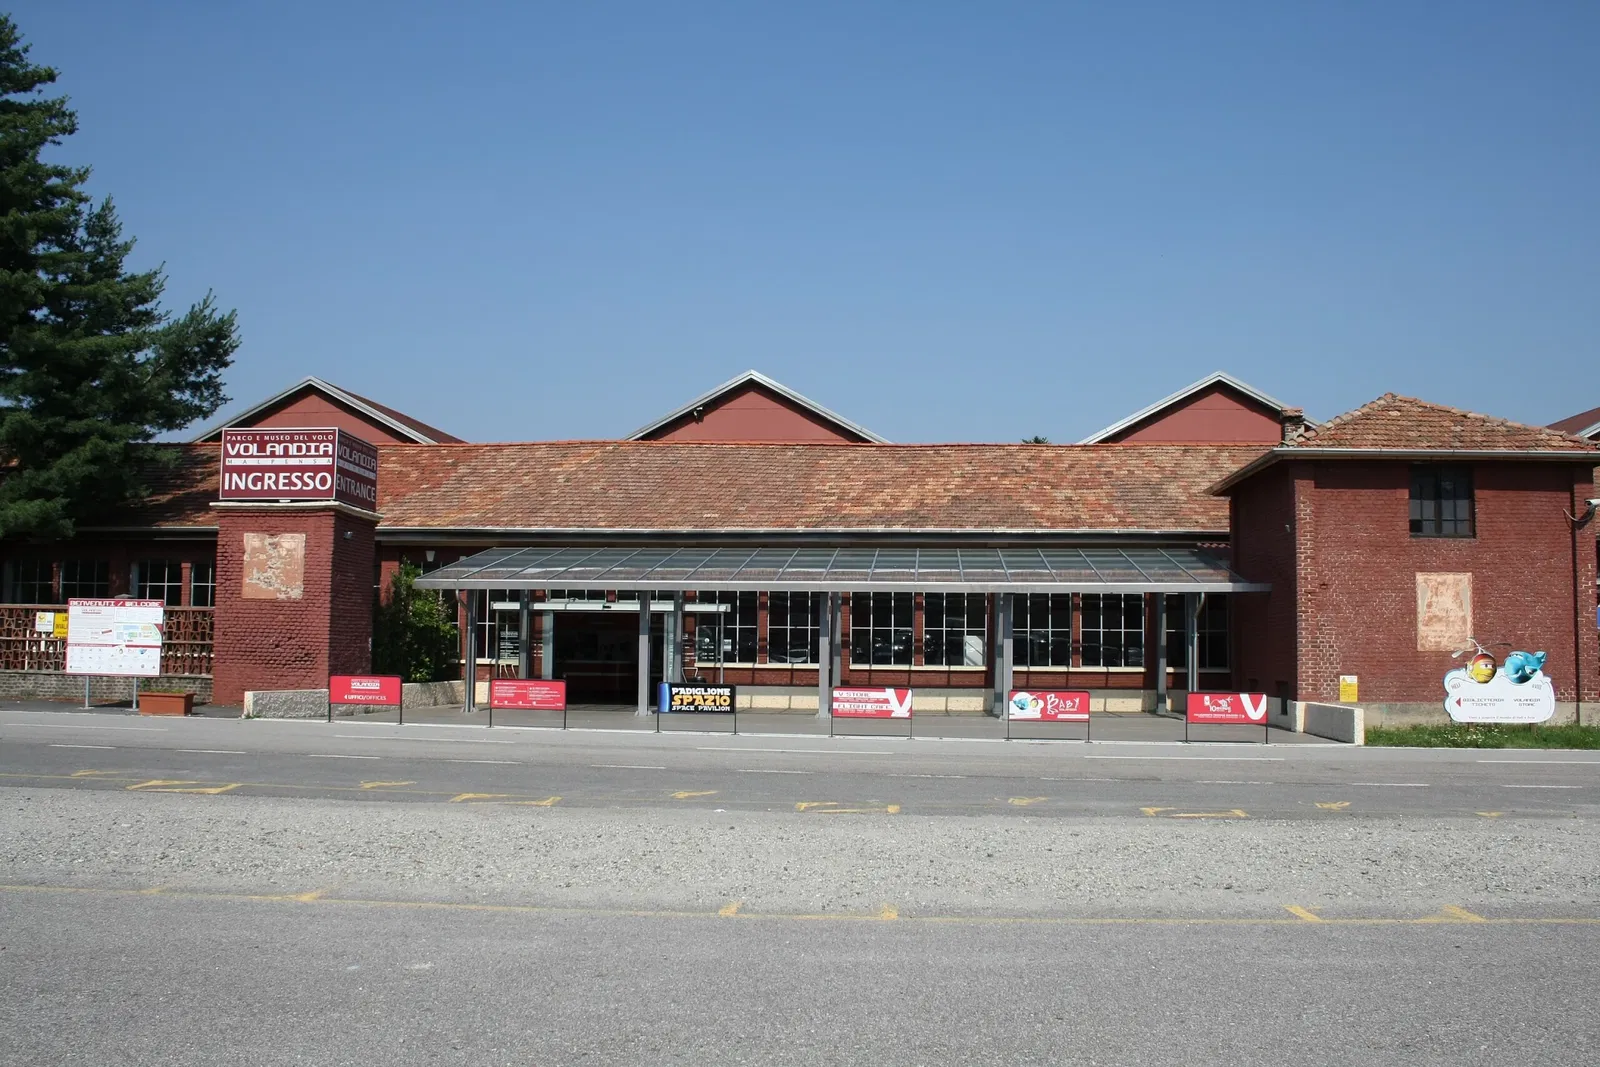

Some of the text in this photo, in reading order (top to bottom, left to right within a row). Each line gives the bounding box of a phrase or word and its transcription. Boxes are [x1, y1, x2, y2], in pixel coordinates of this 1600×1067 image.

[226, 442, 333, 456] VOLANDIA
[337, 443, 377, 471] VOLANDIA
[224, 472, 332, 491] INGRESSO
[336, 473, 376, 502] ENTRANCE
[671, 687, 731, 696] PADIGLIONE
[671, 695, 731, 706] SPAZIO
